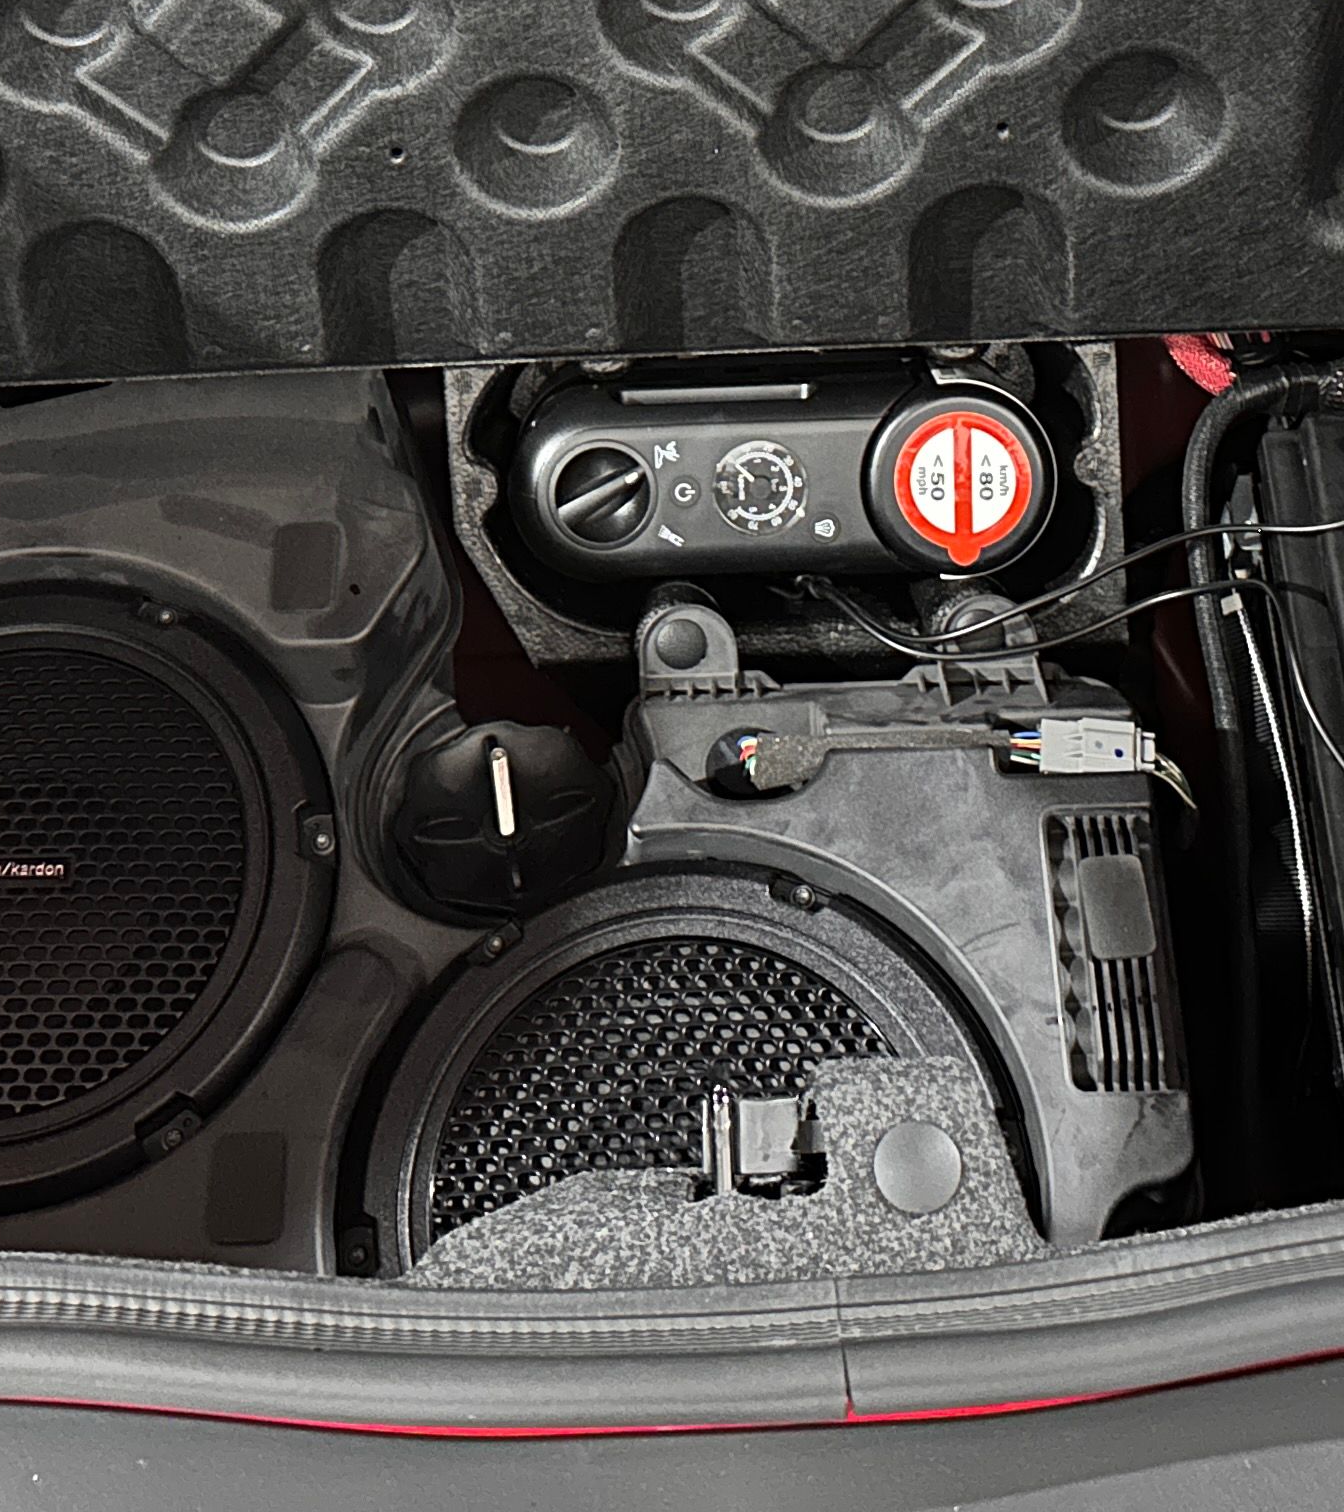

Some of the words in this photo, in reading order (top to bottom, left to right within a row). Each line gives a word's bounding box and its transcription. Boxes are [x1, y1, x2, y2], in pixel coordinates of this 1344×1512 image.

[916, 466, 928, 496] mph
[930, 472, 945, 501] 50
[979, 472, 994, 501] 80
[999, 464, 1010, 496] km/h
